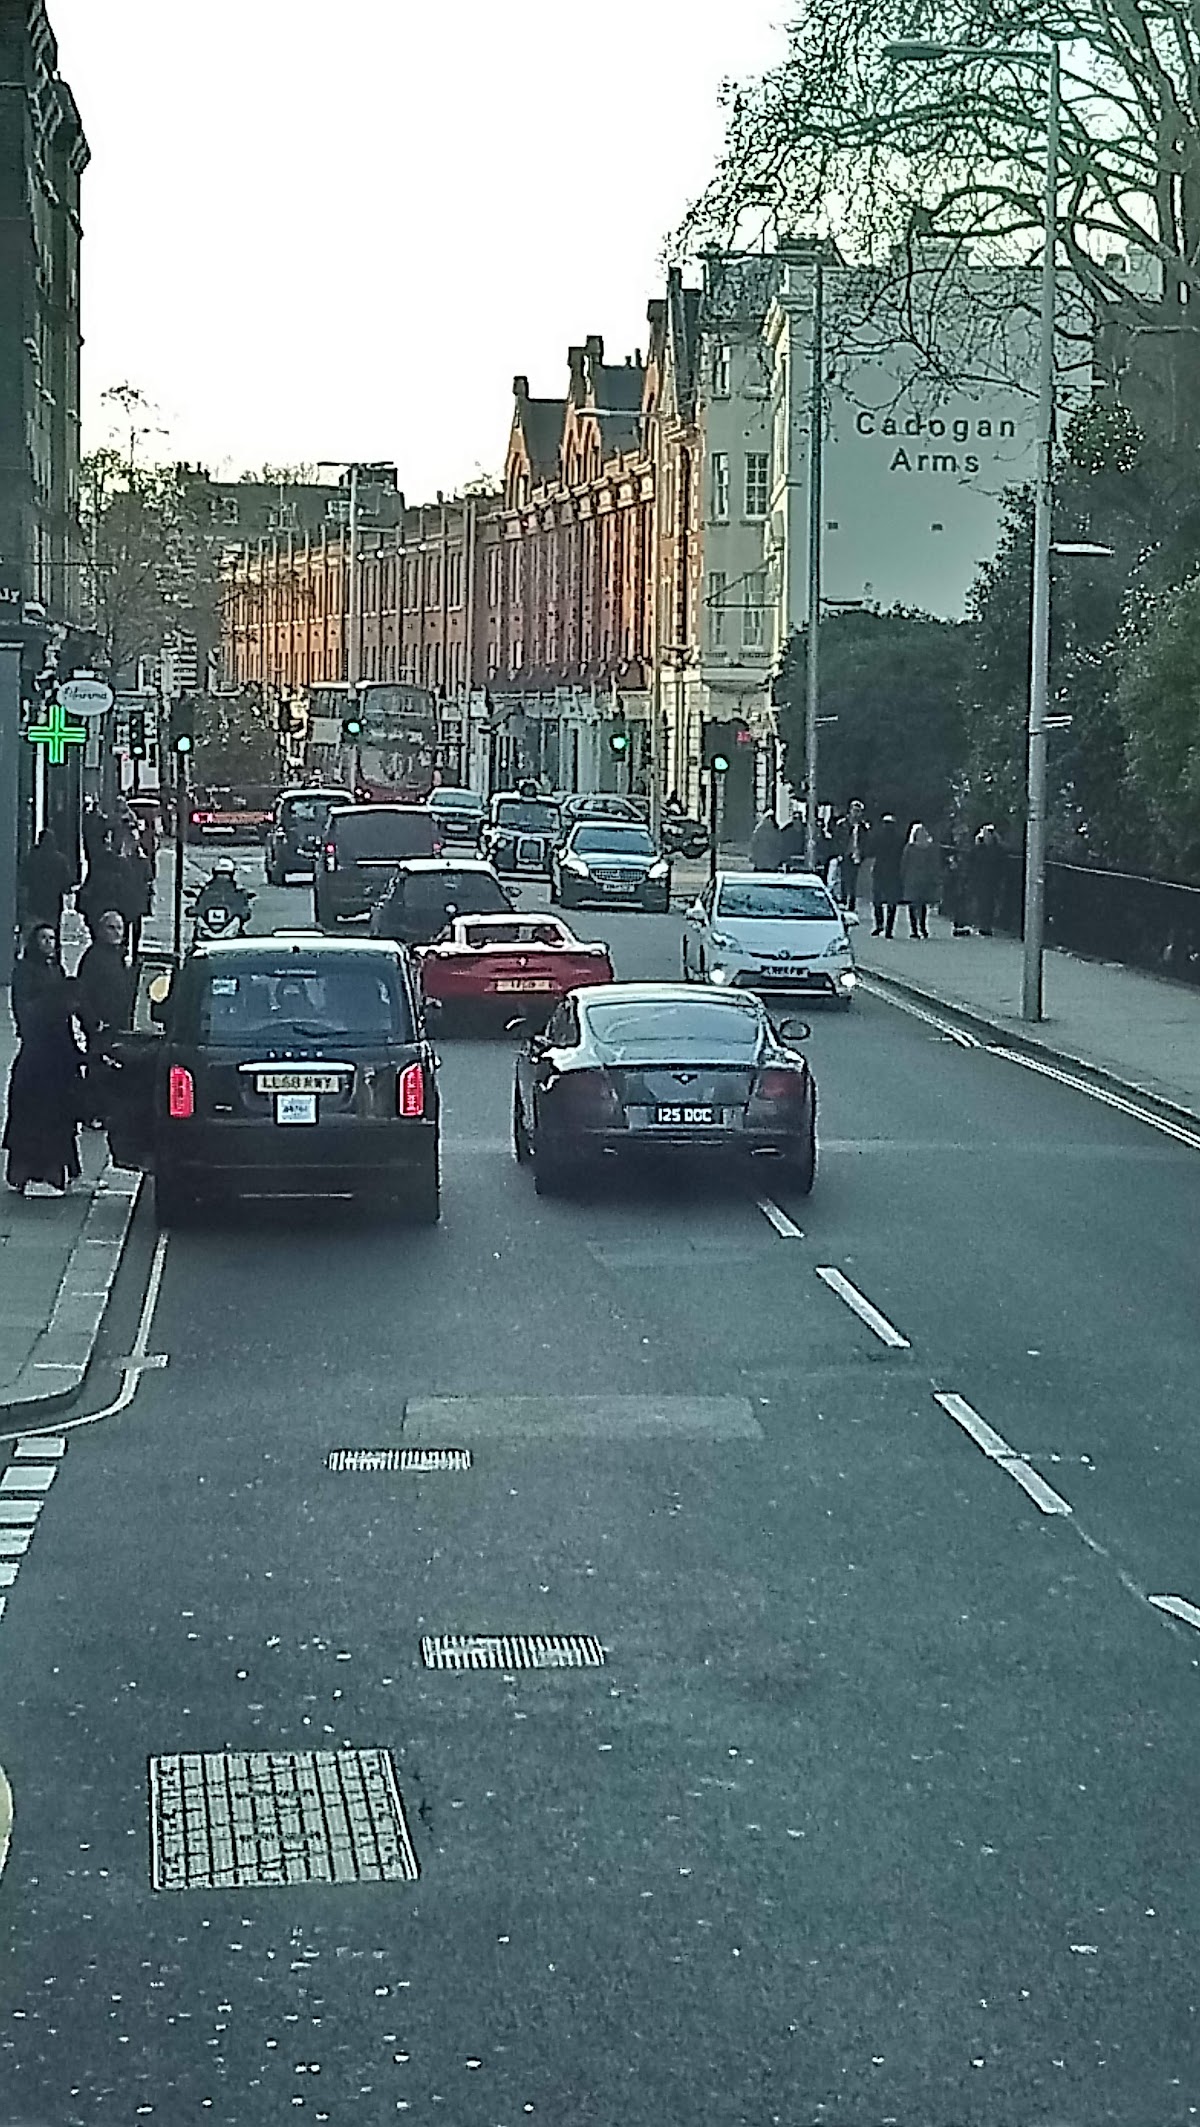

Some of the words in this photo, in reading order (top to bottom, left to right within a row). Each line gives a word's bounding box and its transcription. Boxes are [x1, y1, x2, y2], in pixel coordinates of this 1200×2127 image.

[856, 411, 1015, 443] Cadogan
[889, 447, 980, 473] Arms
[658, 1108, 681, 1122] 125
